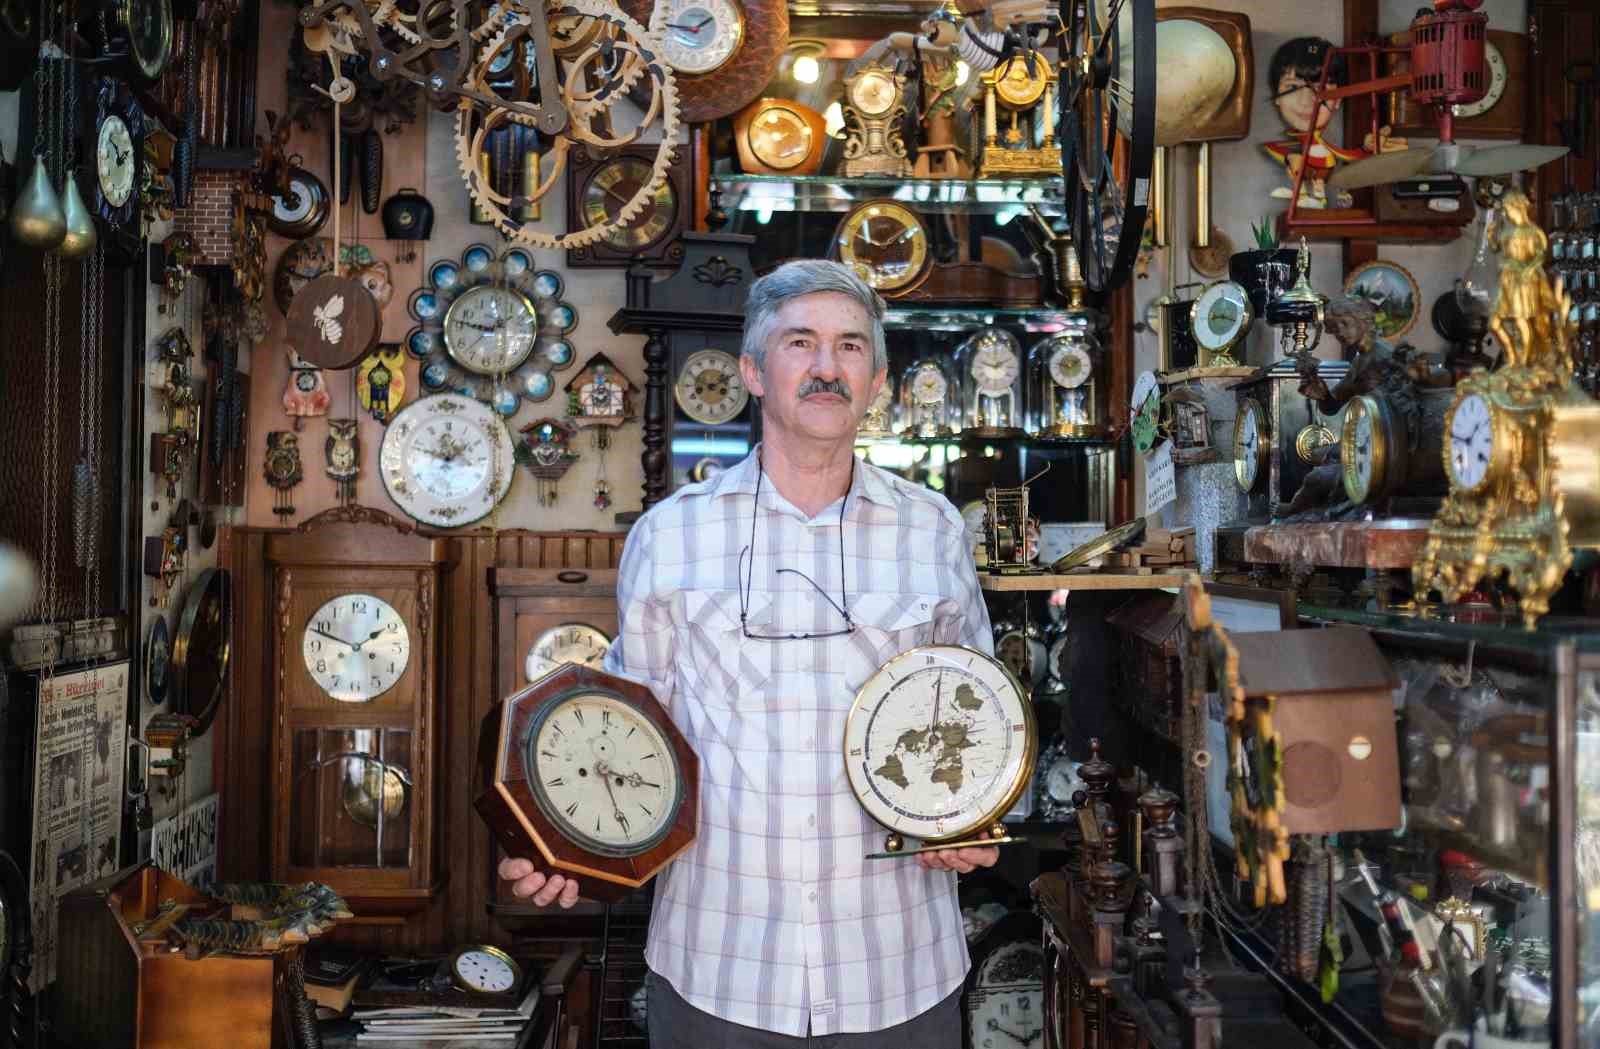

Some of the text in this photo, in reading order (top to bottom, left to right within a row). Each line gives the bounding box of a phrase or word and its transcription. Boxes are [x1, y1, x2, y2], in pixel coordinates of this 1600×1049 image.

[351, 601, 366, 614] 12
[375, 607, 381, 620] 1
[317, 621, 330, 633] 10
[569, 630, 582, 645] 12
[316, 660, 326, 673] 8
[386, 662, 395, 674] 4
[1017, 996, 1030, 1010] 12
[1001, 1003, 1009, 1017] 11
